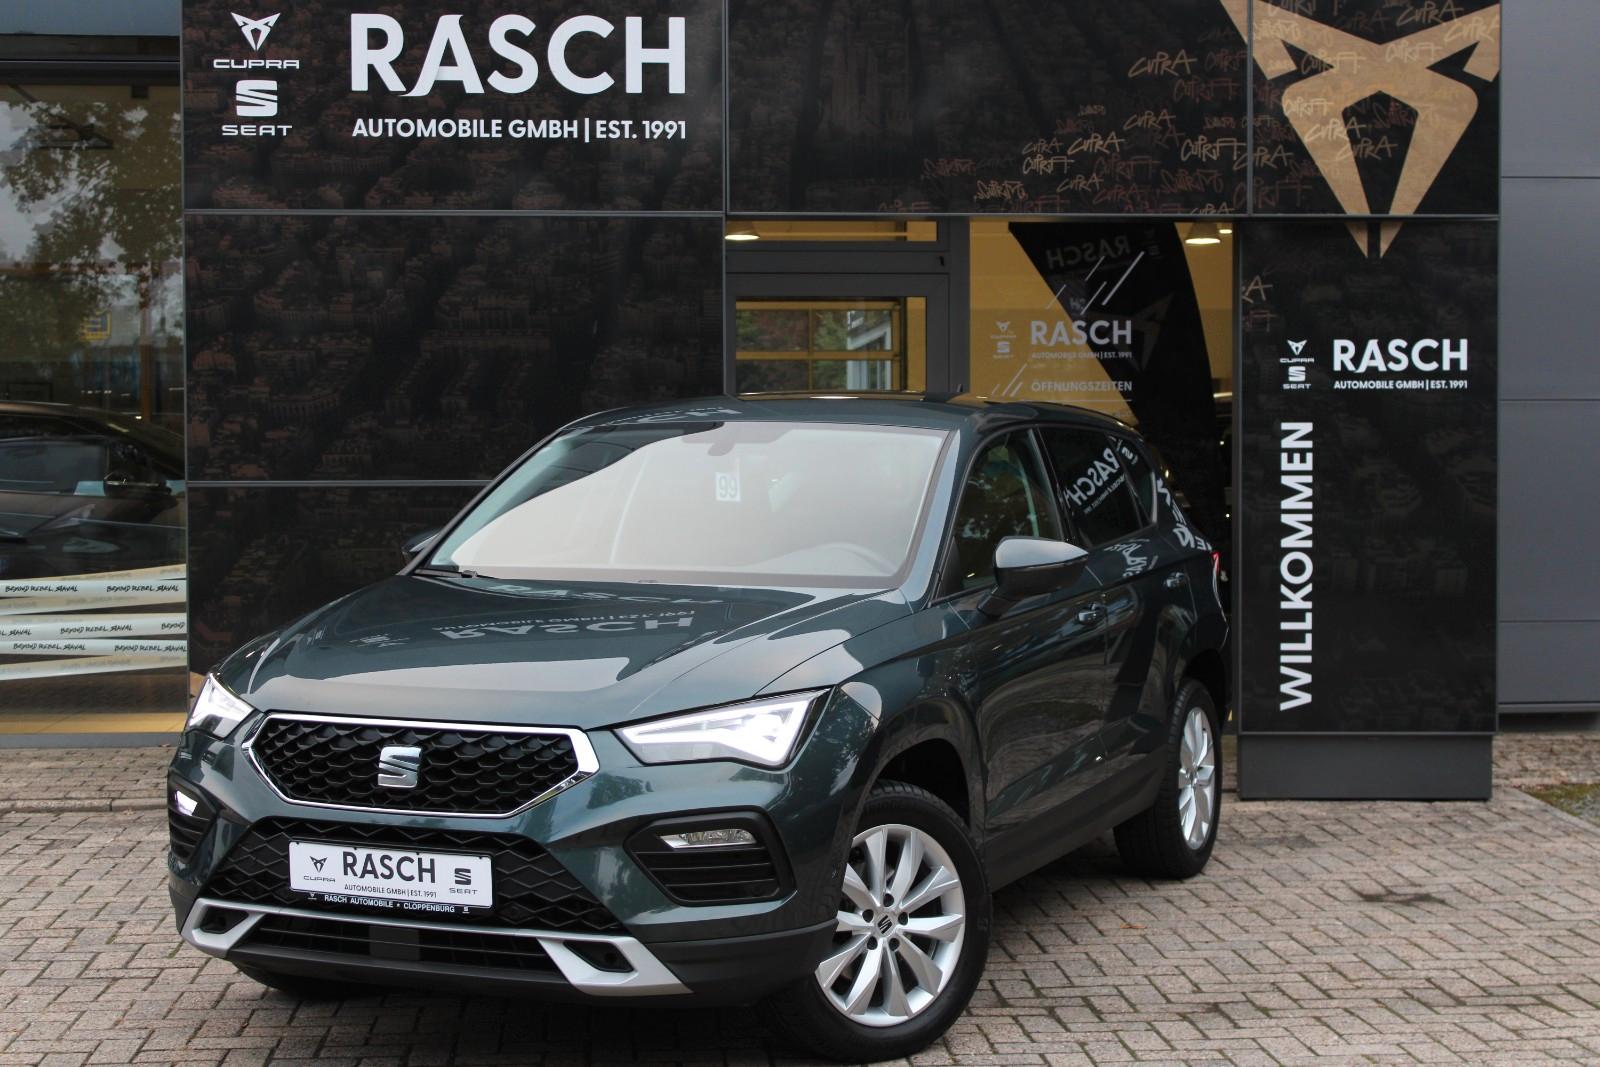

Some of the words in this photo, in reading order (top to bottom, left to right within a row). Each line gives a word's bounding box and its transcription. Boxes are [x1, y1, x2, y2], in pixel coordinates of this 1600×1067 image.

[213, 59, 300, 69] CUPRA
[351, 13, 686, 97] RASCH
[222, 125, 293, 136] SEAT
[352, 118, 503, 138] AUTOMOBILE
[508, 119, 578, 139] GMBH
[595, 120, 637, 139] EST.
[643, 120, 686, 139] 1991
[1031, 320, 1132, 346] RASCH
[1332, 338, 1468, 373] RASCH
[1031, 380, 1132, 392] ÖFFNUNGSZEITEN
[1334, 380, 1394, 390] AUTOMOBILE
[1396, 380, 1424, 390] GMBH
[1430, 380, 1448, 390] EST.
[1449, 380, 1468, 390] 1991
[719, 475, 737, 498] 99
[1280, 421, 1313, 711] WILLKOMMEN
[343, 851, 436, 884] RASCH
[304, 875, 336, 883] CUPRA
[344, 884, 385, 894] AUTOMOBILE
[386, 887, 406, 896] GMBH
[410, 889, 423, 897] EST.
[423, 890, 437, 899] 1991
[324, 894, 347, 904] RASCH
[350, 897, 393, 908] AUTOMOBILE
[403, 902, 455, 913] CLOPPENBURG
